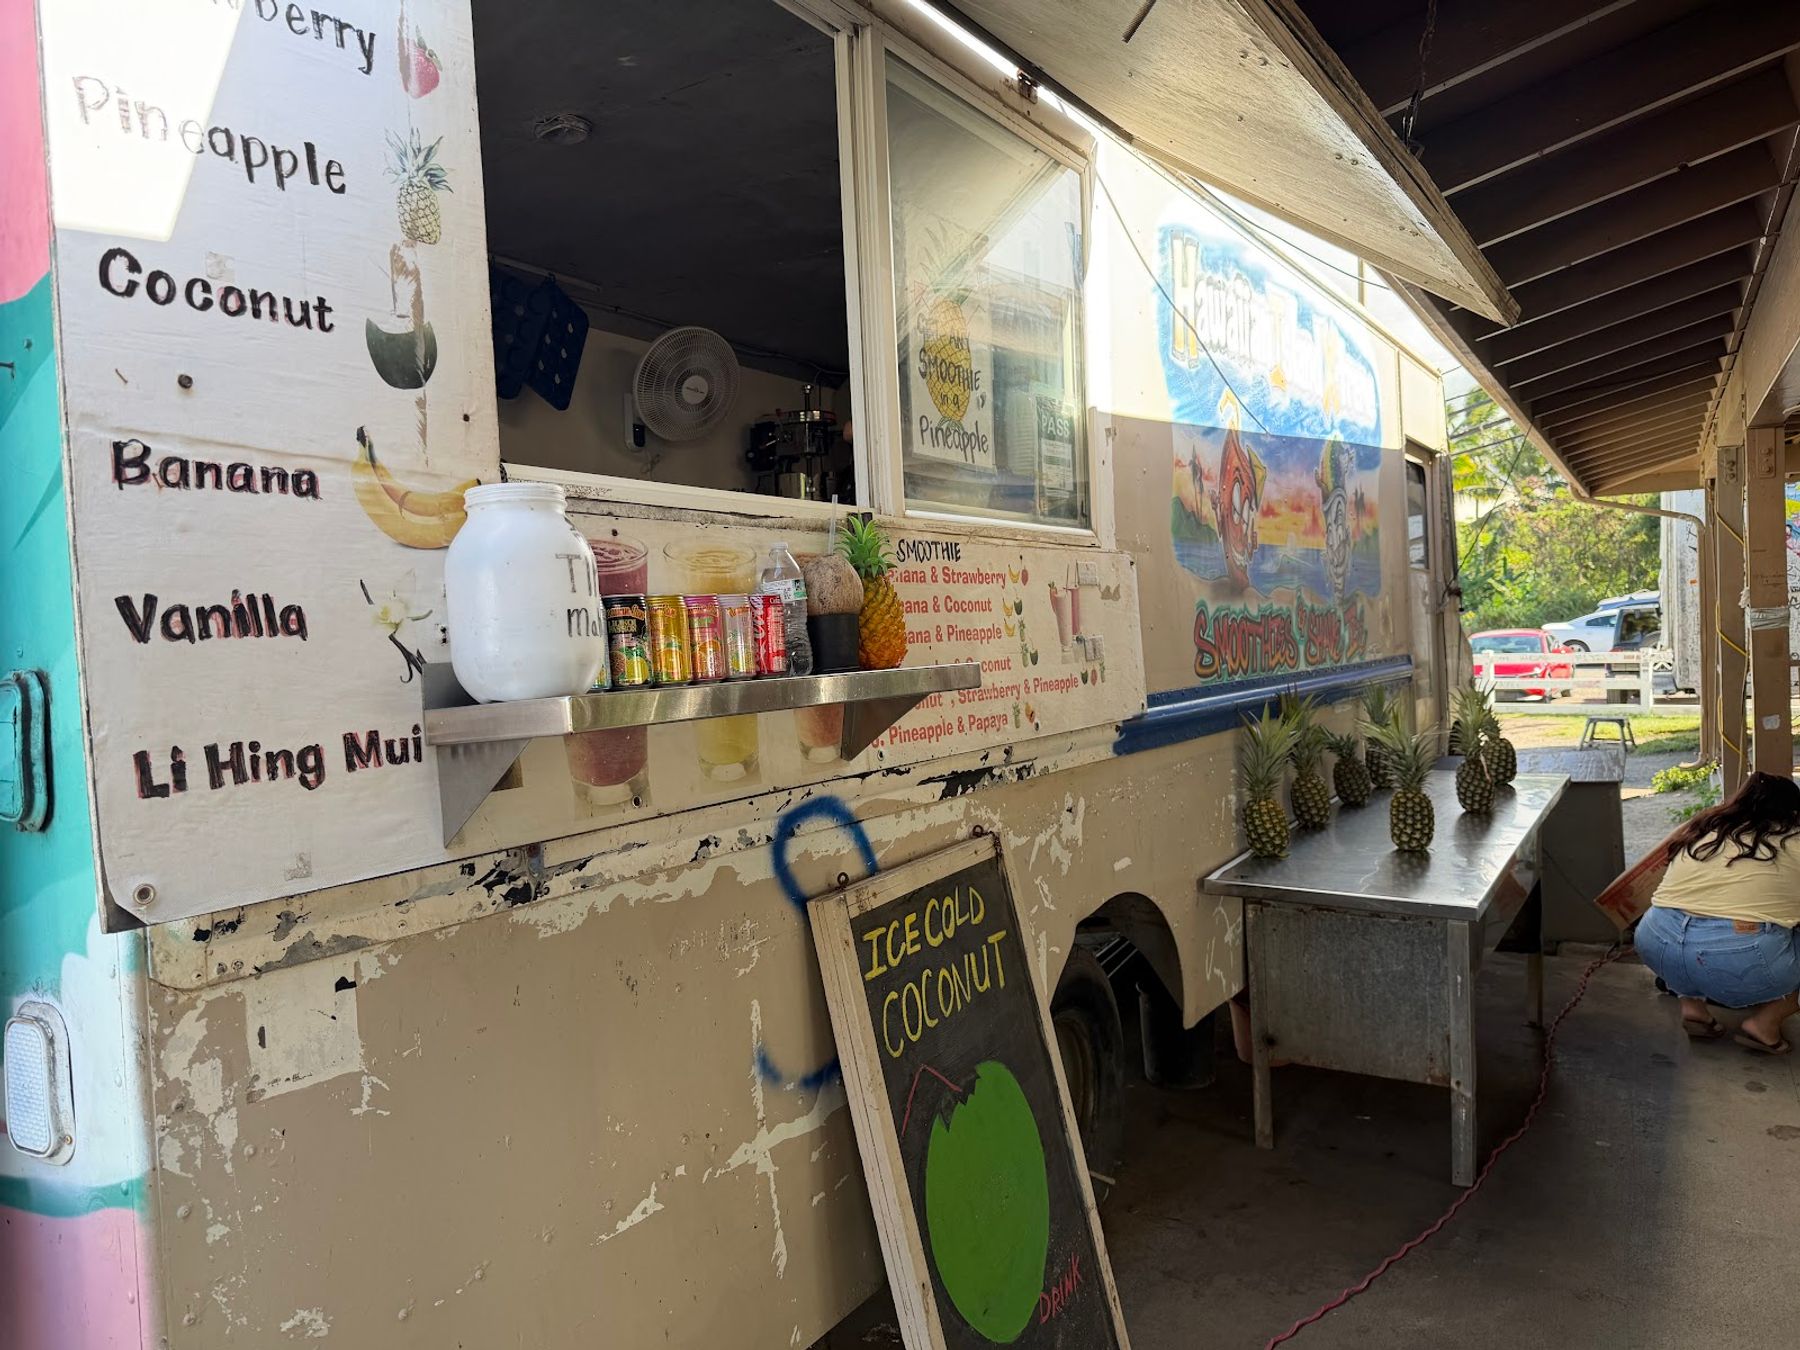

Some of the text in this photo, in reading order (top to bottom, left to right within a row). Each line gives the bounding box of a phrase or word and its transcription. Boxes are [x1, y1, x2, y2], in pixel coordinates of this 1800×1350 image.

[72, 76, 347, 195] Pineapple
[99, 246, 336, 333] Coconut
[918, 347, 981, 392] SMOOTHIE
[919, 414, 989, 464] Pineapple
[1041, 413, 1070, 438] PASS
[112, 439, 324, 500] Banana
[896, 538, 961, 563] SMOOTHIE
[930, 565, 939, 584] &
[942, 565, 1006, 589] Strawberry
[114, 588, 308, 645] Vanilla
[932, 595, 941, 613] &
[944, 594, 992, 613] Coconut
[935, 625, 943, 643] &
[946, 623, 1003, 645] Pineapple
[1194, 608, 1299, 679] SMOOTHIES
[957, 682, 1021, 705] Strawberry
[1023, 677, 1031, 694] &
[1033, 673, 1079, 696] Pineapple
[888, 718, 954, 745] Pineapple
[957, 716, 965, 733] &
[968, 711, 1009, 733] Papaya
[133, 724, 423, 799] Li Hing Mui
[862, 885, 986, 982] ICE COLD
[882, 929, 1007, 1059] COCONUT
[1039, 1251, 1082, 1325] DRINK
